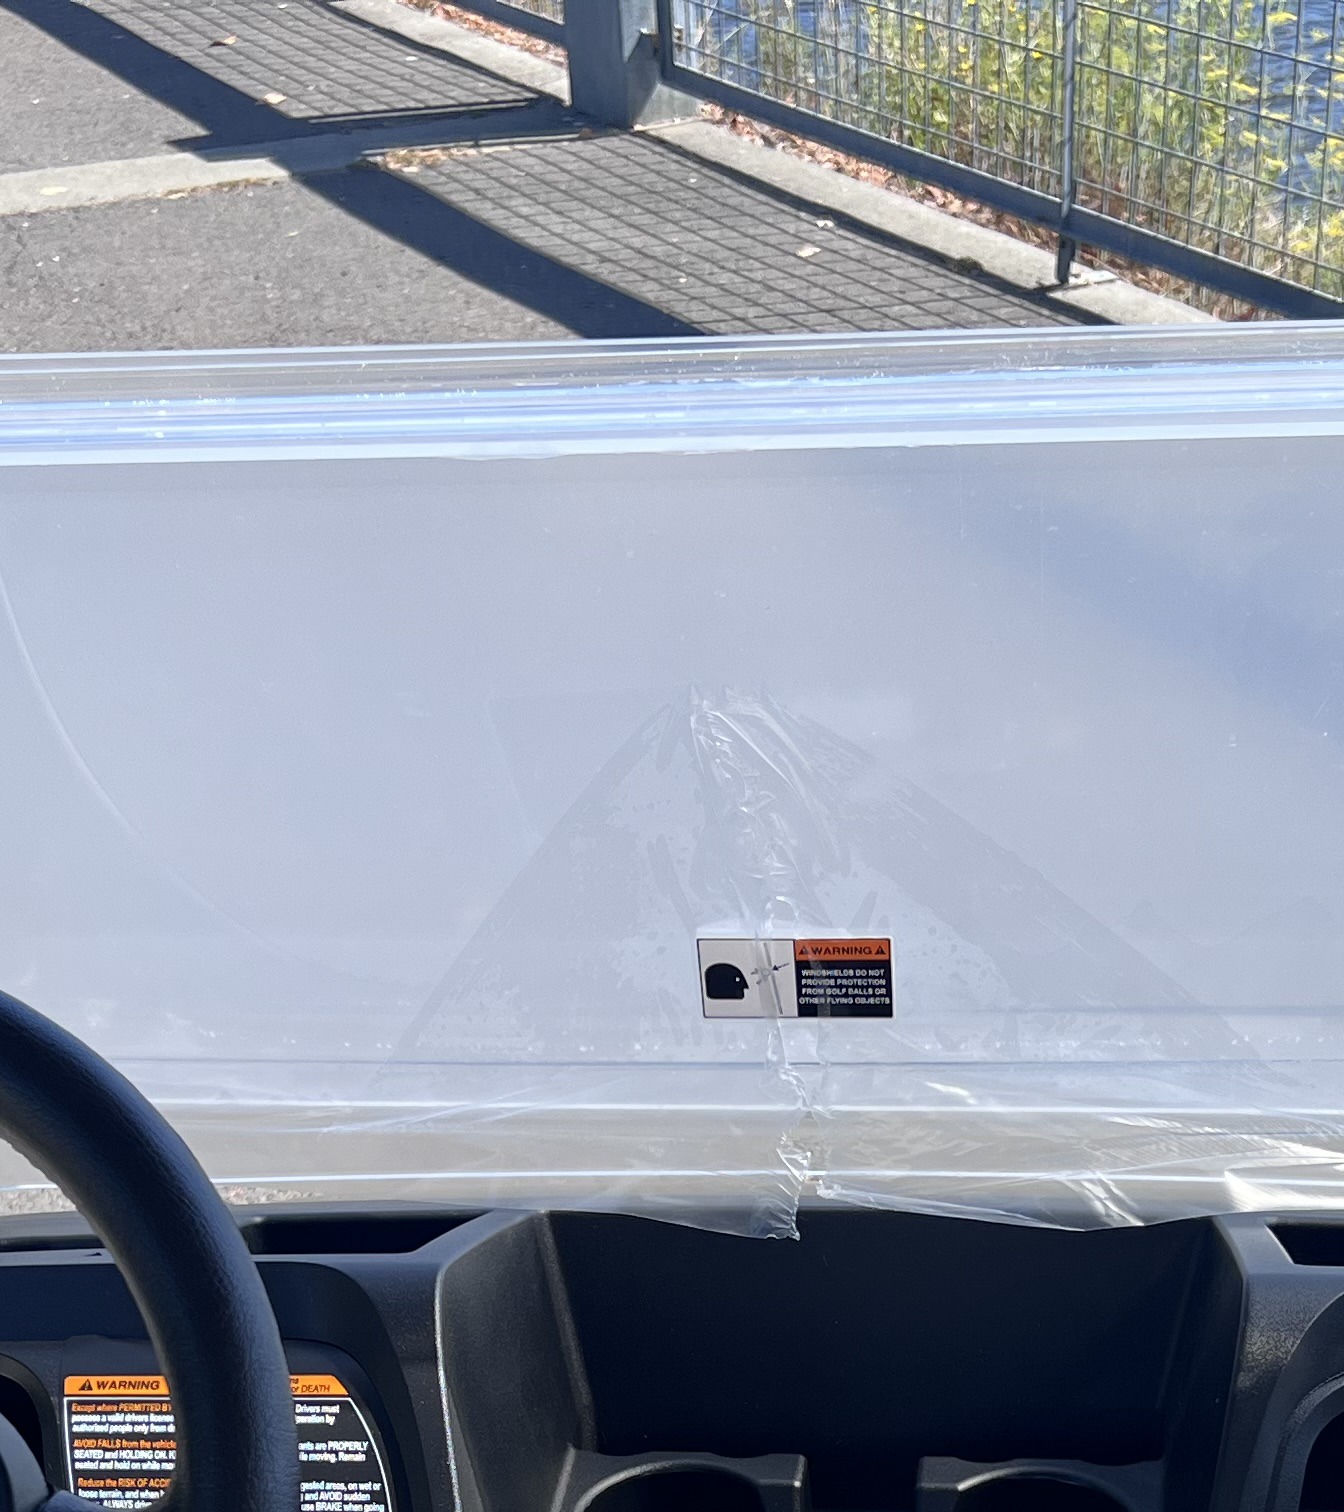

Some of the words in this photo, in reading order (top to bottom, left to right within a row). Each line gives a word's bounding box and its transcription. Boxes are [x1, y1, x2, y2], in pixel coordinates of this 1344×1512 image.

[811, 946, 873, 956] WARNING
[801, 969, 854, 977] WINDSHIELDS
[855, 969, 867, 977] DO
[868, 969, 885, 977] NOT
[799, 996, 825, 1005] OTHER
[826, 996, 854, 1005] FLYING
[854, 996, 890, 1005] OBJECTS
[96, 1380, 161, 1391] WARNING
[300, 1384, 331, 1393] DEATH
[119, 1403, 161, 1412] PERMITTED
[295, 1404, 320, 1413] Drivers
[321, 1404, 340, 1413] must
[325, 1414, 336, 1426] by
[109, 1423, 133, 1434] people
[133, 1423, 150, 1434] only
[73, 1439, 97, 1448] AVOID
[97, 1439, 122, 1448] FALLS
[139, 1440, 151, 1448] the
[327, 1441, 369, 1451] PROPERLY
[74, 1450, 104, 1459] SEATED
[104, 1450, 118, 1459] and
[118, 1450, 153, 1459] HOLDING
[308, 1452, 337, 1463] moving.
[338, 1452, 366, 1462] Remain
[78, 1478, 105, 1487] Reduce
[105, 1478, 117, 1487] the
[117, 1478, 137, 1487] RISK
[137, 1478, 148, 1487] OF
[347, 1482, 358, 1490] on
[358, 1481, 373, 1490] wet
[372, 1482, 382, 1490] or
[319, 1492, 343, 1501] AVOID
[343, 1492, 371, 1501] sudden
[102, 1500, 133, 1509] ALWAYS
[315, 1502, 343, 1511] BRAKE
[343, 1502, 363, 1511] when
[363, 1502, 385, 1512] going
